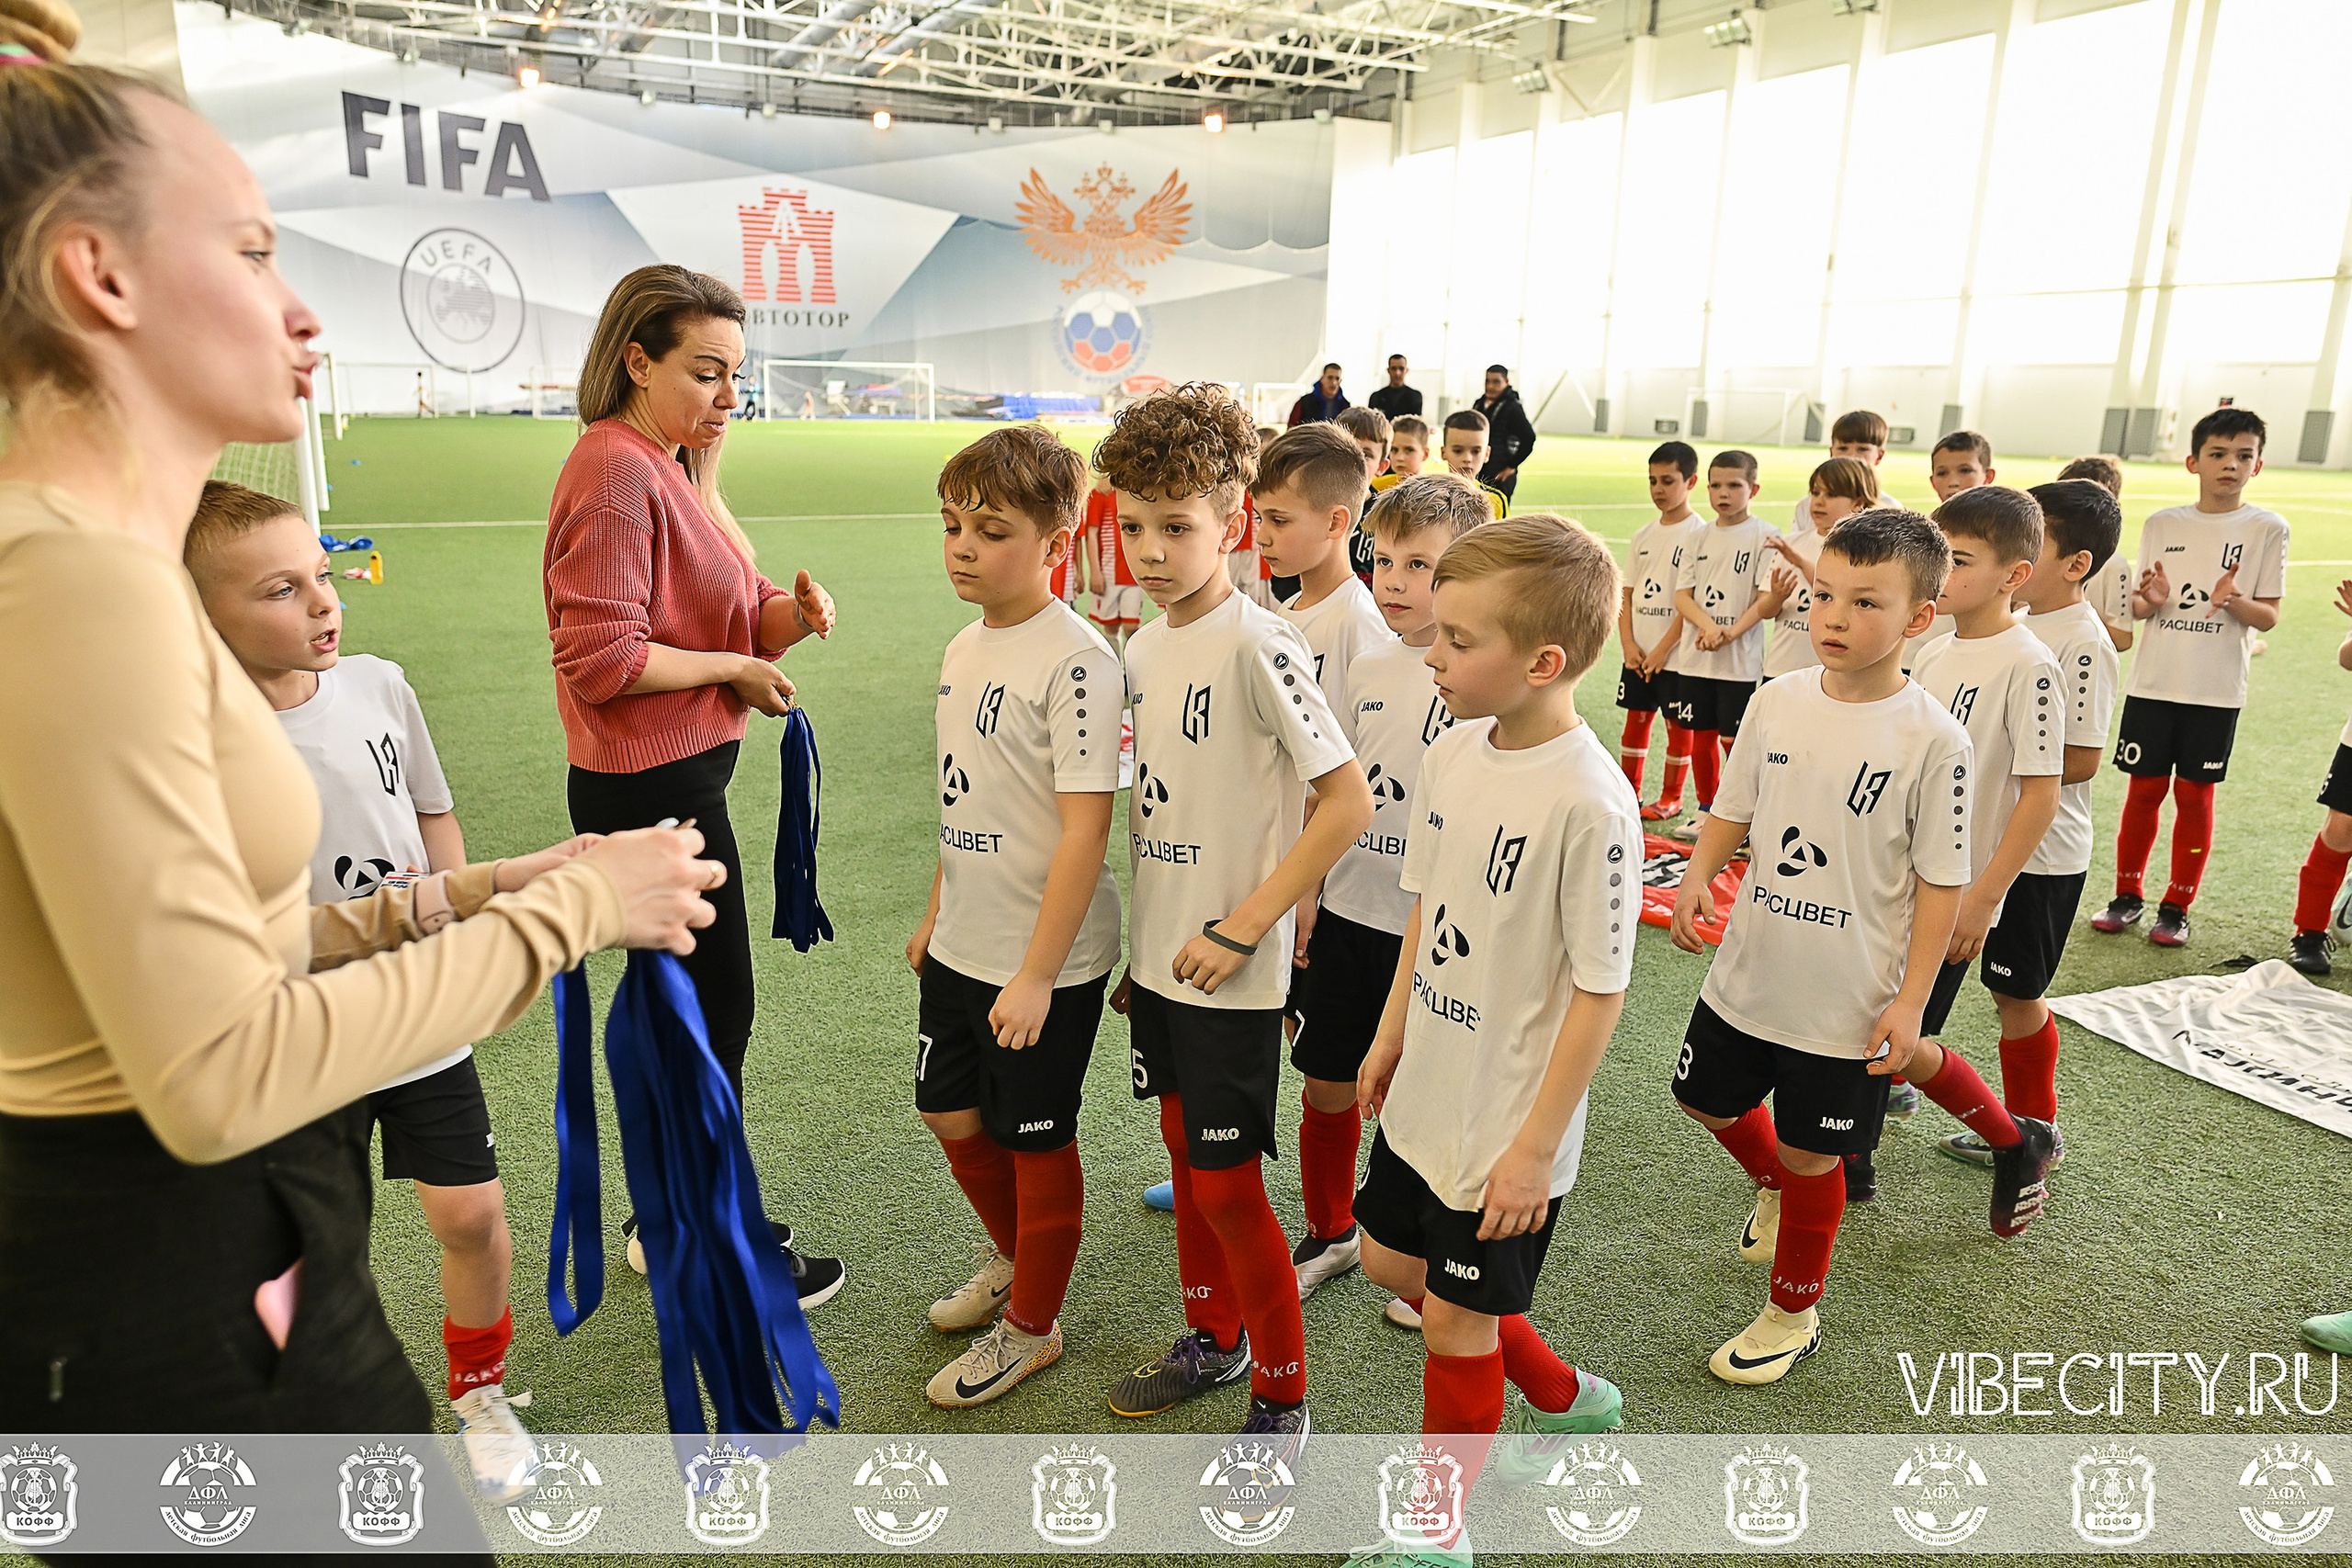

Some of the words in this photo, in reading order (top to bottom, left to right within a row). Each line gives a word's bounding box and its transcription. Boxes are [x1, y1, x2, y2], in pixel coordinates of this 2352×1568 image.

[342, 91, 549, 202] FIFA
[420, 240, 493, 275] UEFA
[751, 308, 850, 327] ВТОТОР
[2159, 618, 2224, 634] РАСЦВЕТ
[1361, 701, 1384, 713] JAKO
[939, 823, 1003, 853] АСЦВЕТ
[1132, 833, 1202, 865] РСЦВЕТ
[1017, 1119, 1055, 1134] JAKO
[1818, 1116, 1854, 1132] JAKO
[1201, 1127, 1240, 1143] JAKO
[1443, 1258, 1481, 1281] JAKO
[1772, 1275, 1820, 1295] JAKO
